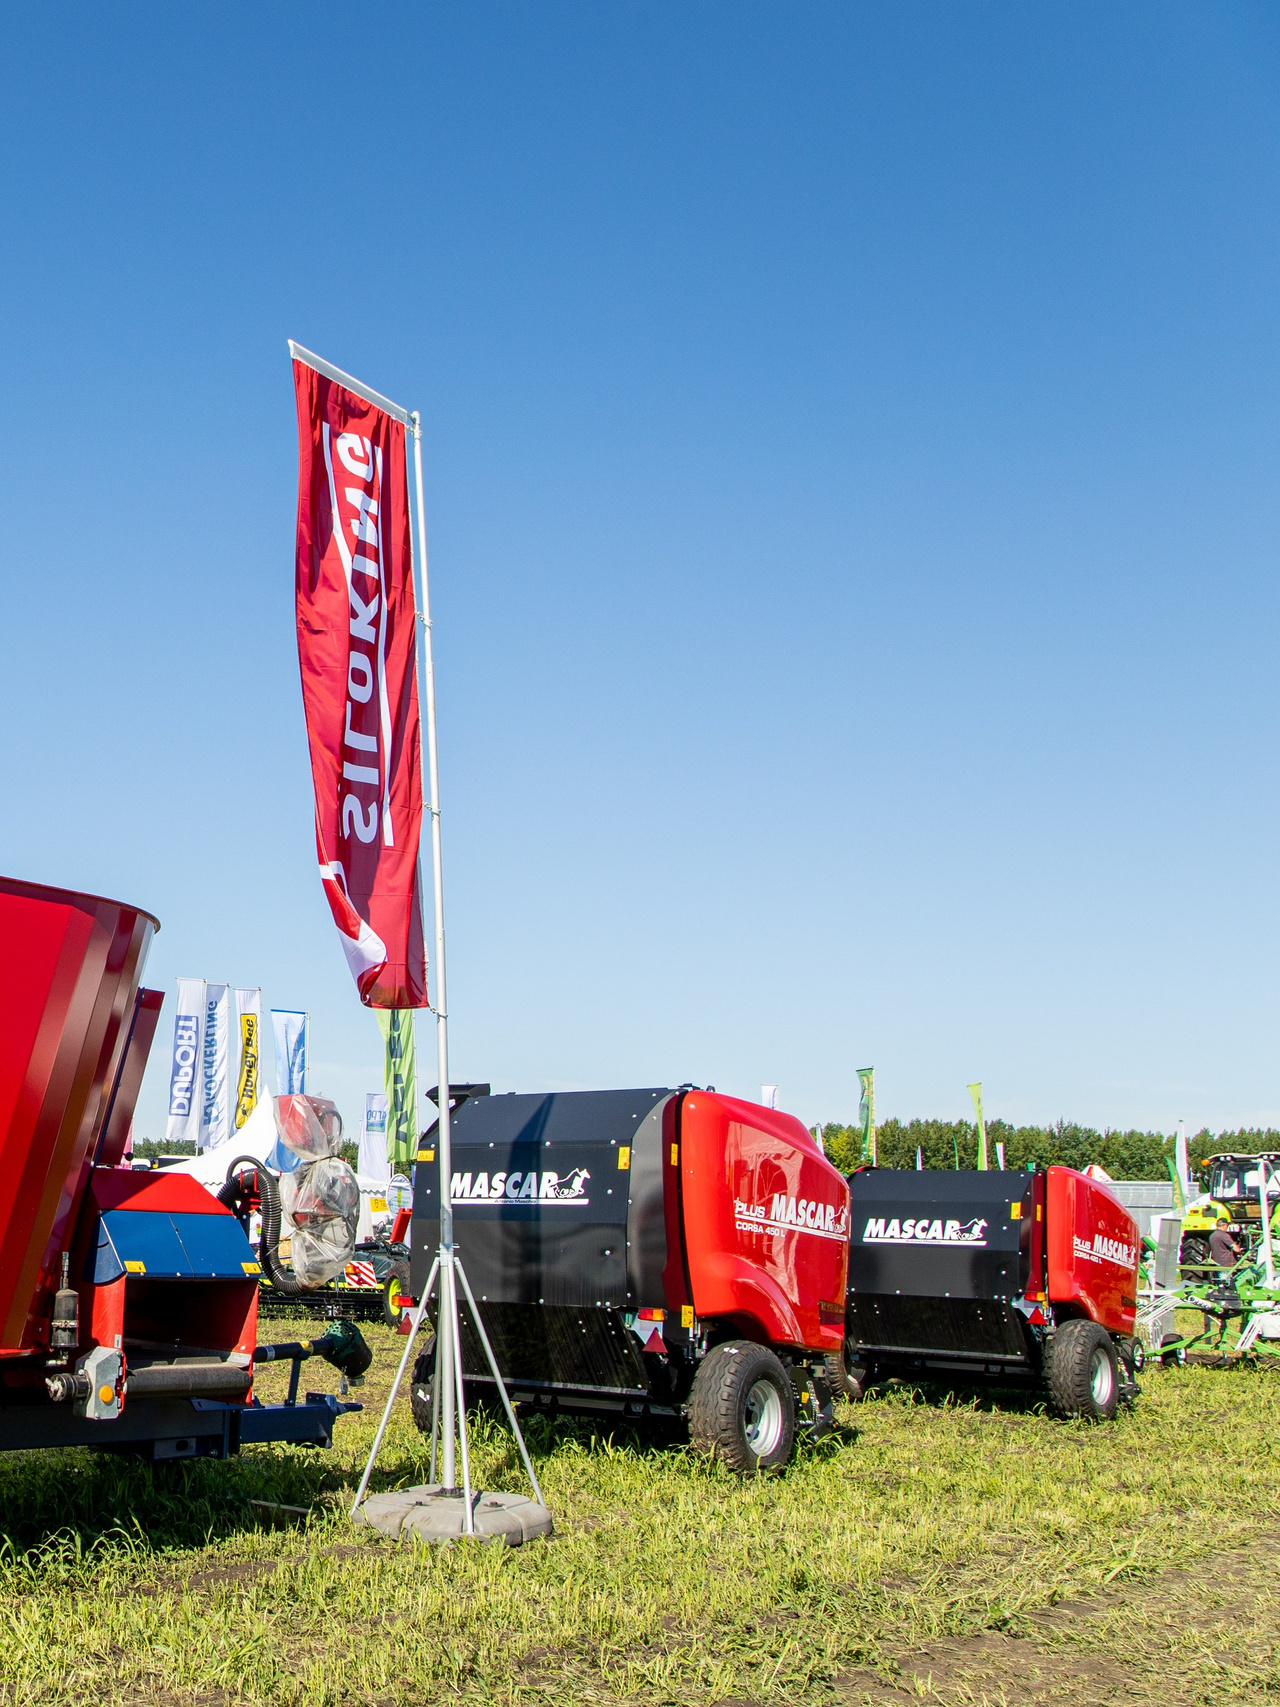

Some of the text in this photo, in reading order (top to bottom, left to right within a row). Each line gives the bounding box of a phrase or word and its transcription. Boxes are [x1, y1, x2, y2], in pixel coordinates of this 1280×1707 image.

[242, 1018, 258, 1099] Honey Bee
[450, 1171, 559, 1199] MASCAR
[734, 1193, 835, 1232] PLUS MASCAR
[735, 1220, 764, 1234] CORSA
[765, 1226, 780, 1237] 450
[863, 1218, 961, 1240] MASCAR
[1093, 1233, 1129, 1262] MASCAR
